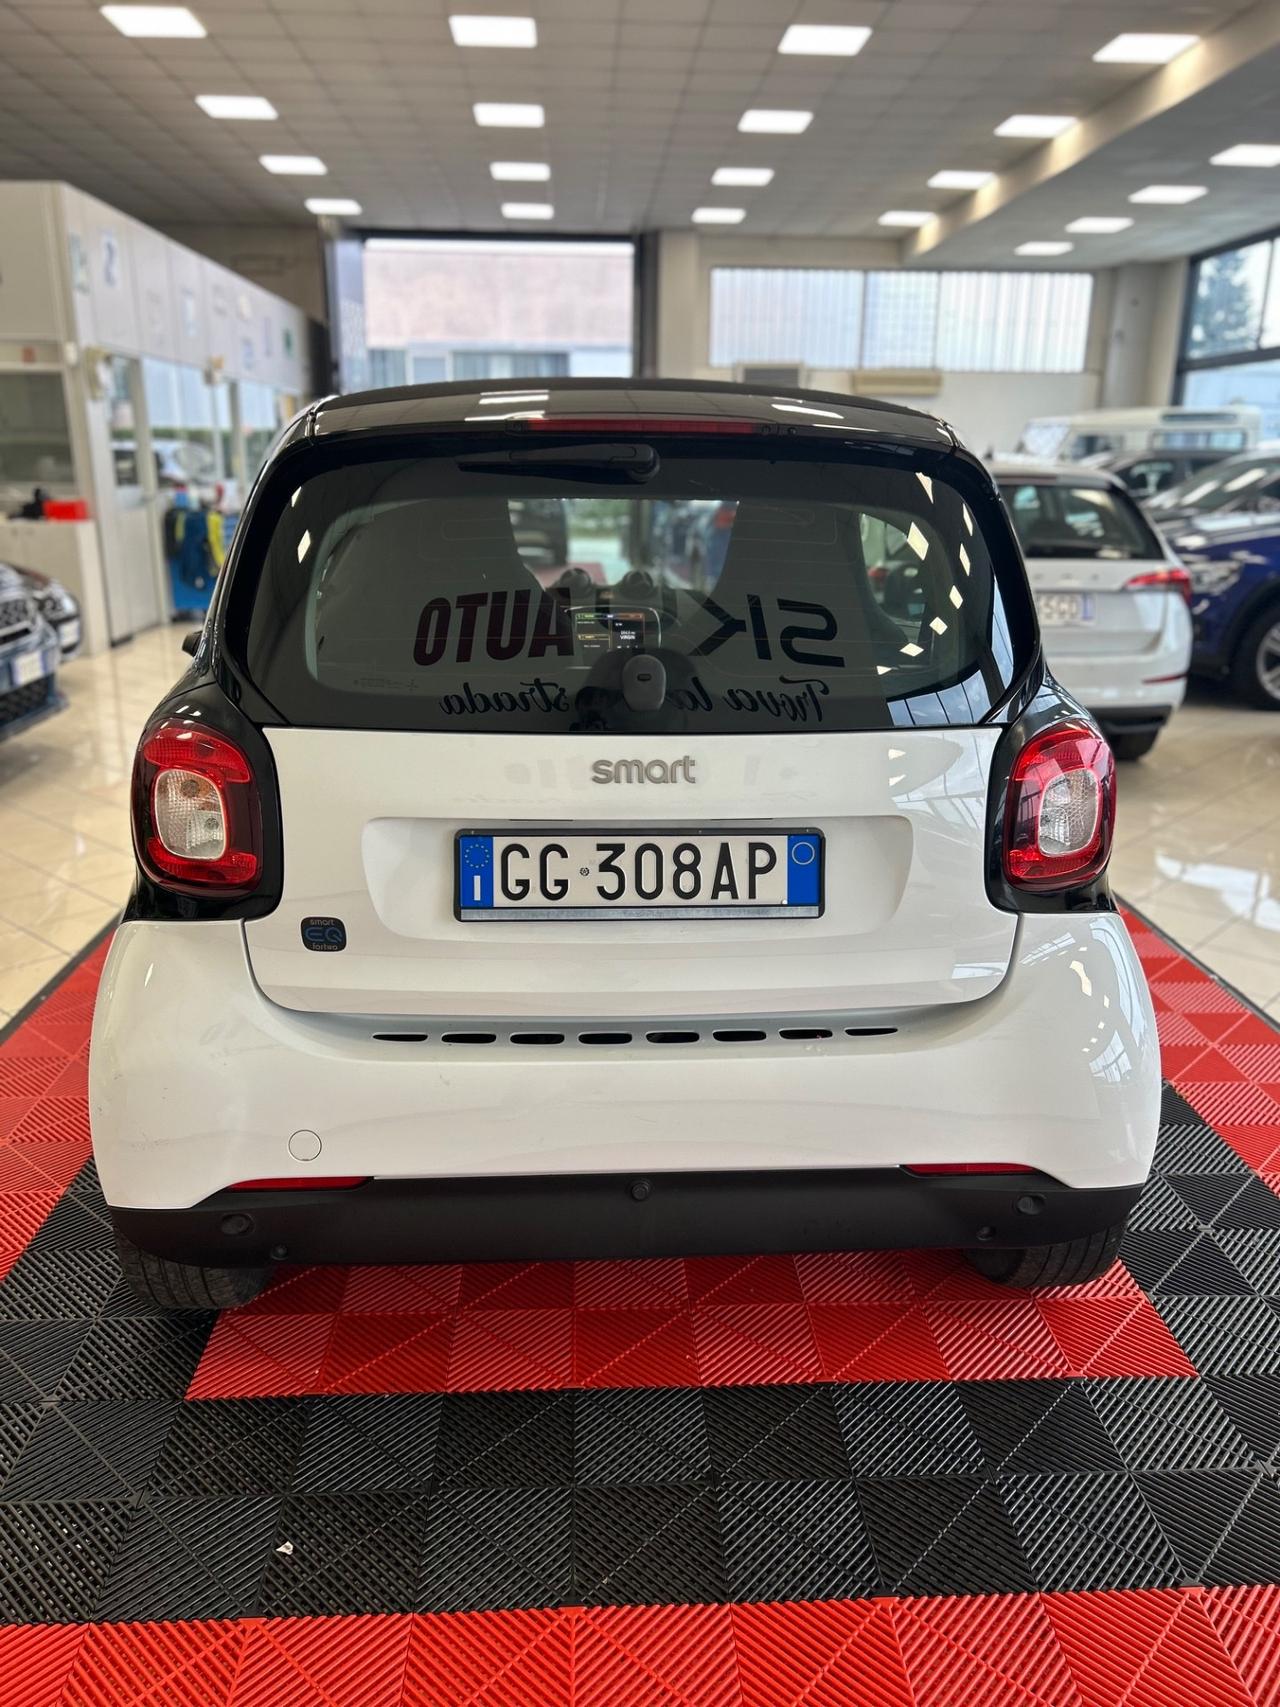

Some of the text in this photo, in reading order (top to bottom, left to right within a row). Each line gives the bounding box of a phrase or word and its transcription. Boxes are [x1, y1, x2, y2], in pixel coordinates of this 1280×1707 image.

[592, 755, 696, 784] smart
[501, 842, 777, 901] GG 308AP
[305, 927, 343, 943] EQ
